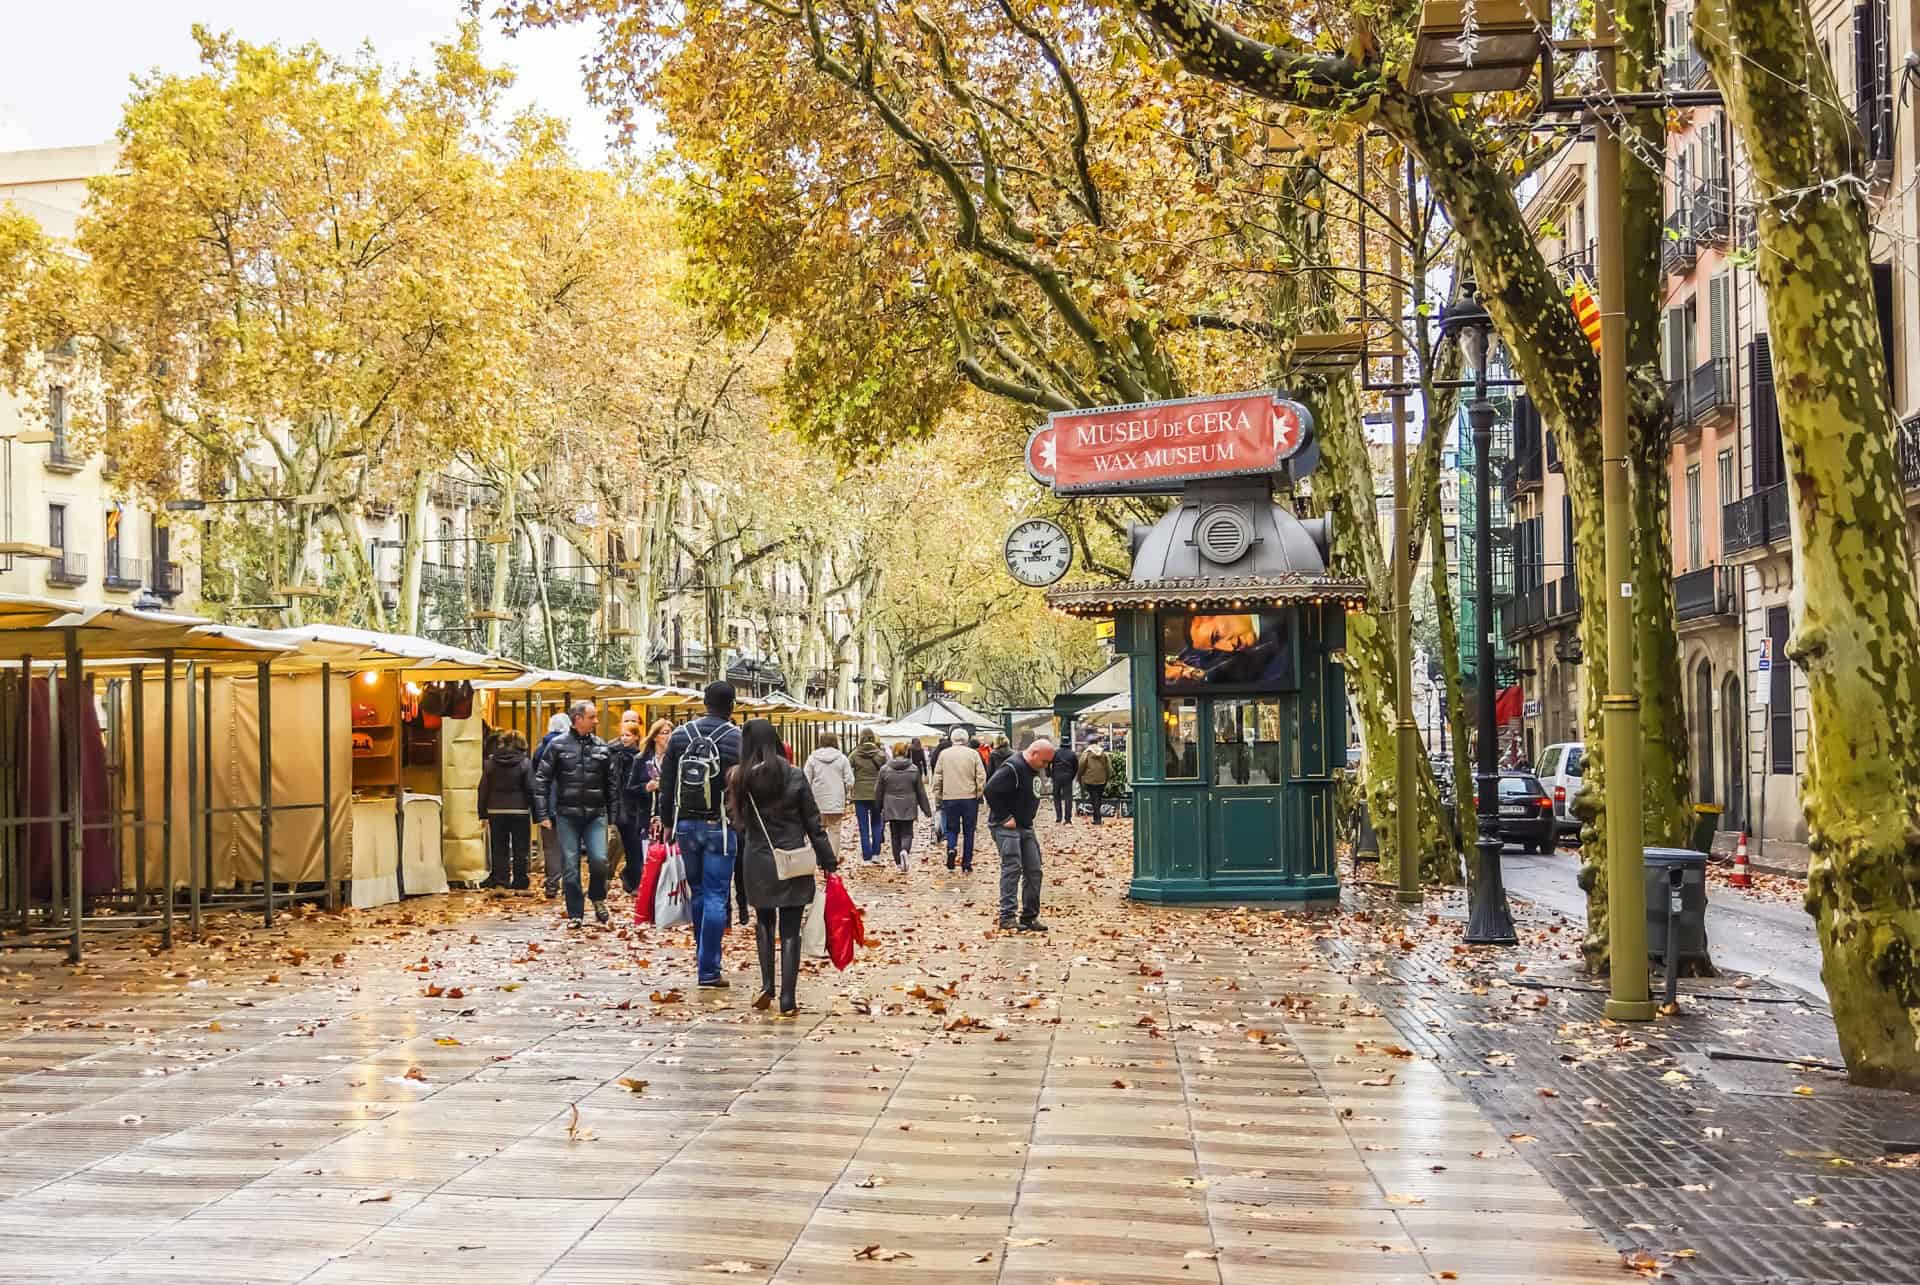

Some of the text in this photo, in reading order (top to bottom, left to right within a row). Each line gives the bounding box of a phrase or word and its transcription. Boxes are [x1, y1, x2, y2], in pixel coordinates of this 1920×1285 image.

[1077, 410, 1251, 446] MUSEU DE CERA
[1093, 443, 1235, 473] WAX MUSEUM
